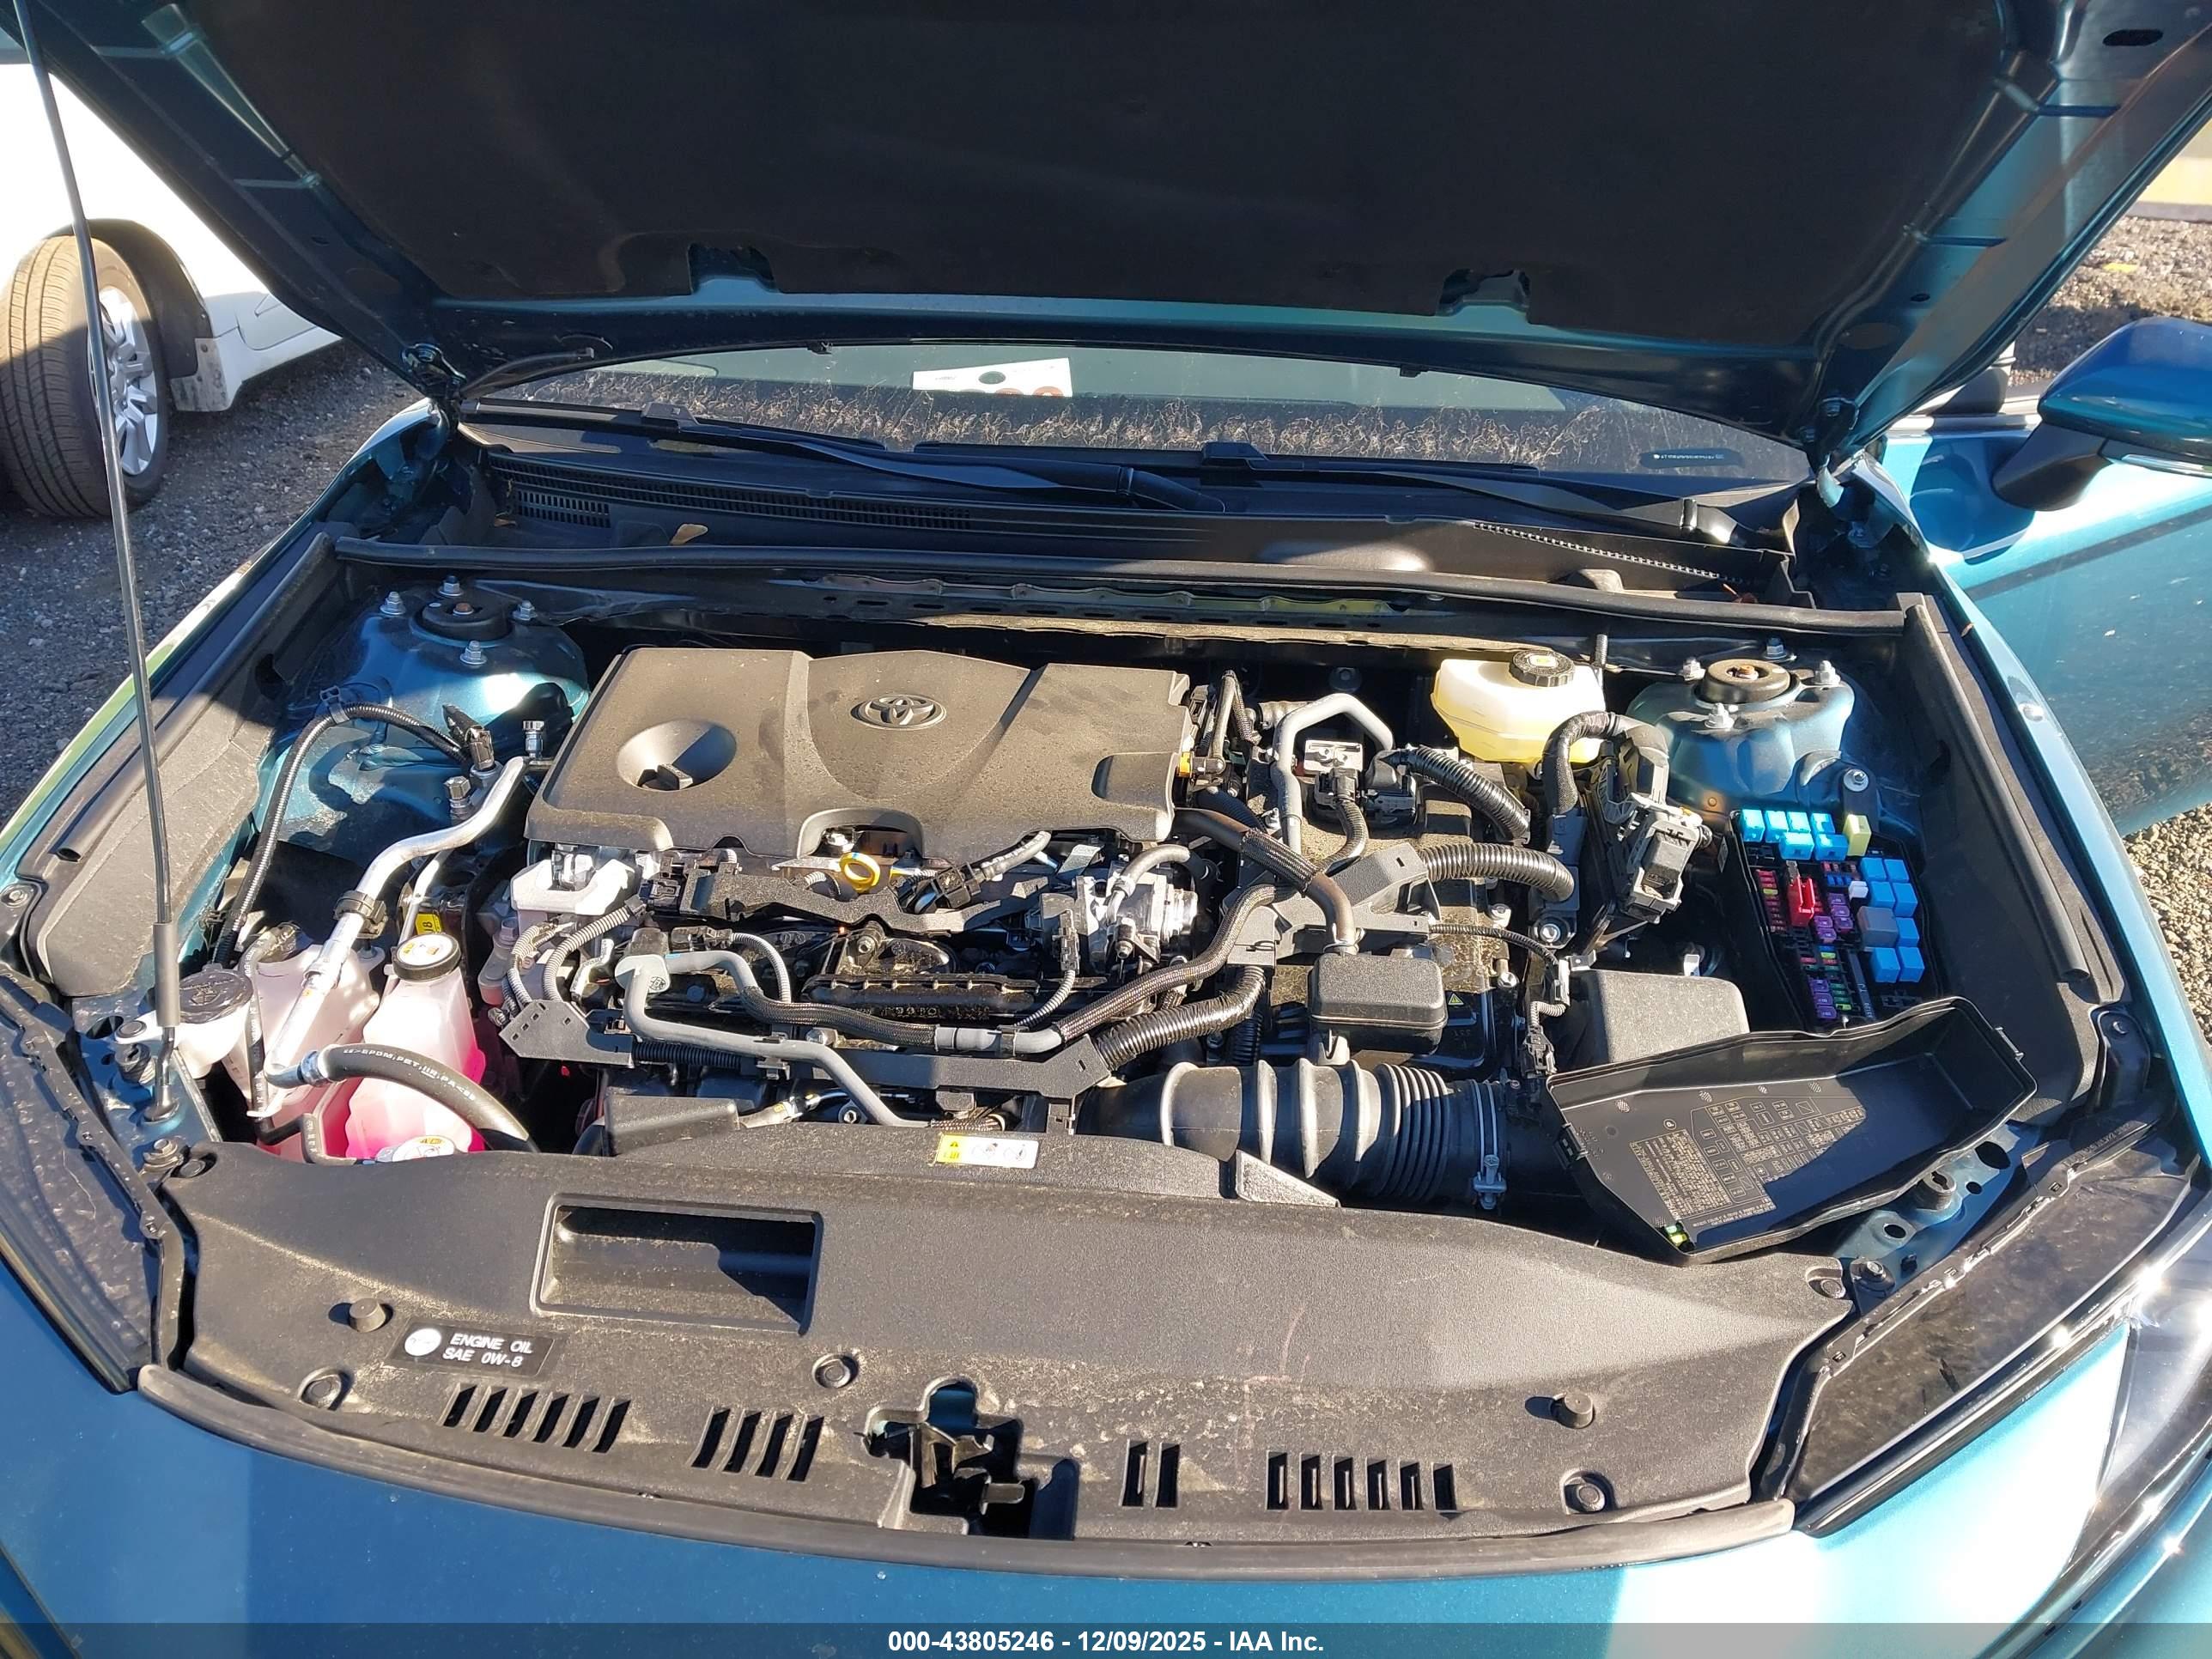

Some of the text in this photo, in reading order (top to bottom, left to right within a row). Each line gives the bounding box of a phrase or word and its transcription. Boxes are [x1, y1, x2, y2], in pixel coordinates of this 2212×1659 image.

[449, 1333, 534, 1354] ENGINE OIL
[442, 1348, 523, 1368] SAE 0W-8
